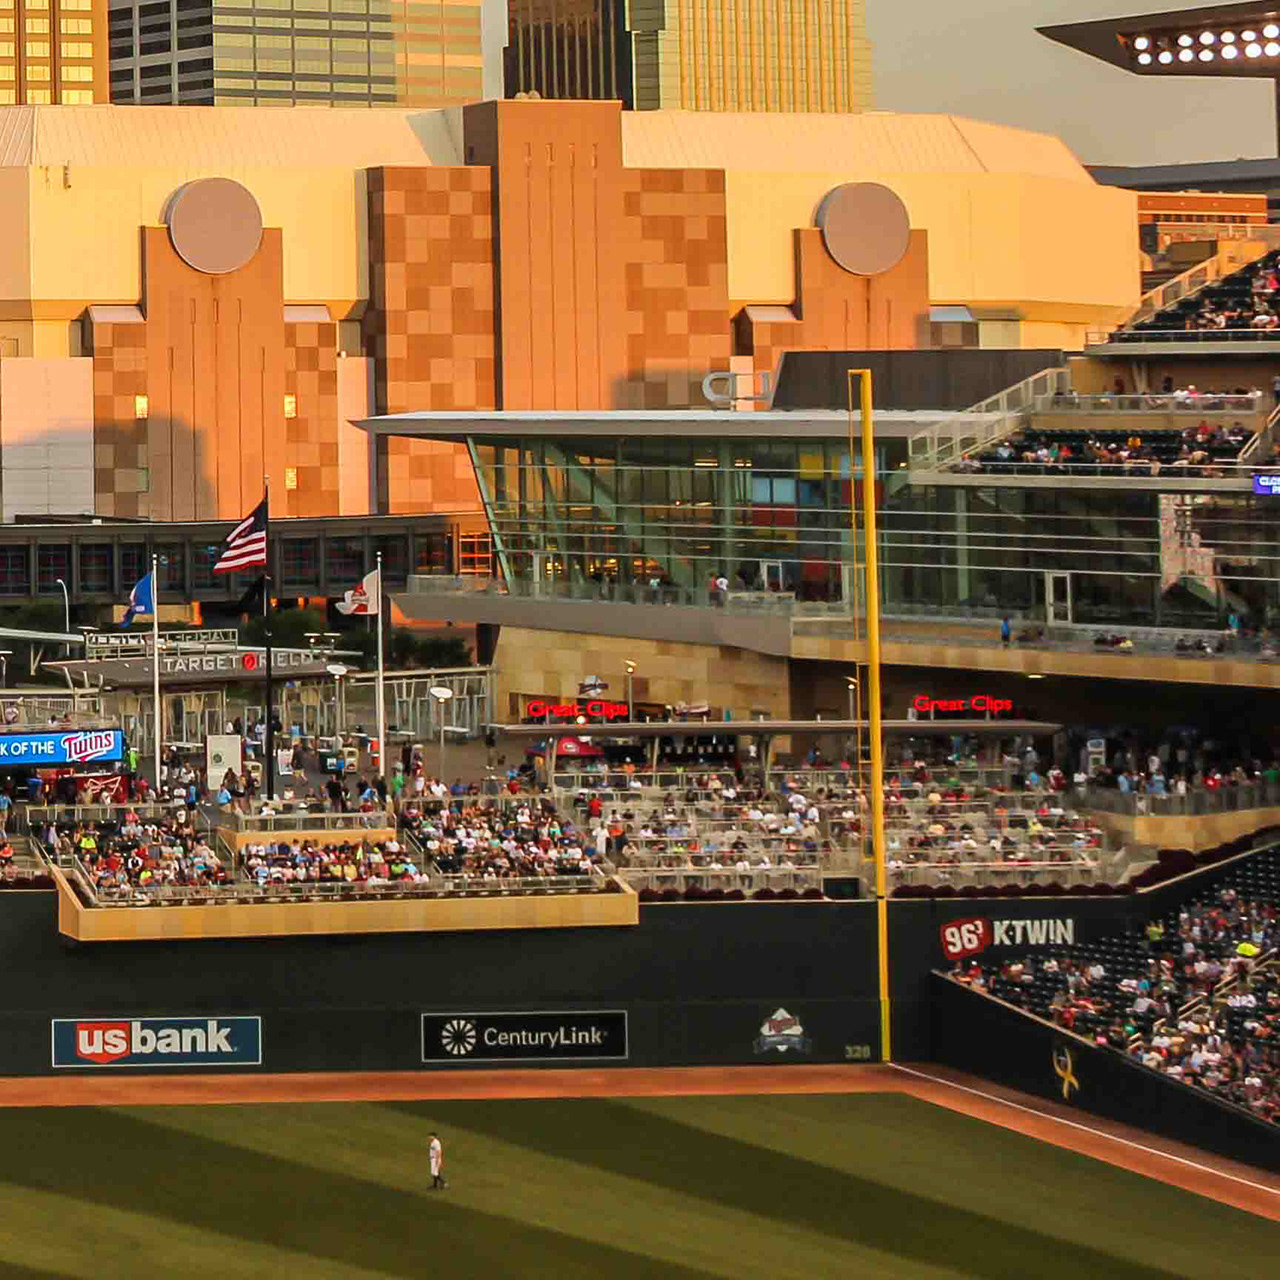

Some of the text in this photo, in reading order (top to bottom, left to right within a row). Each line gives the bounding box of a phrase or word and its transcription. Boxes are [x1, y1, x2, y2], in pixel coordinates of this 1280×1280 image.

[164, 655, 239, 672] TARGET
[528, 700, 629, 720] Great Clips
[913, 694, 1013, 714] Great Clips
[11, 742, 28, 755] OF
[31, 741, 54, 754] THE
[62, 731, 115, 762] Twins
[484, 1026, 603, 1048] CenturyLink
